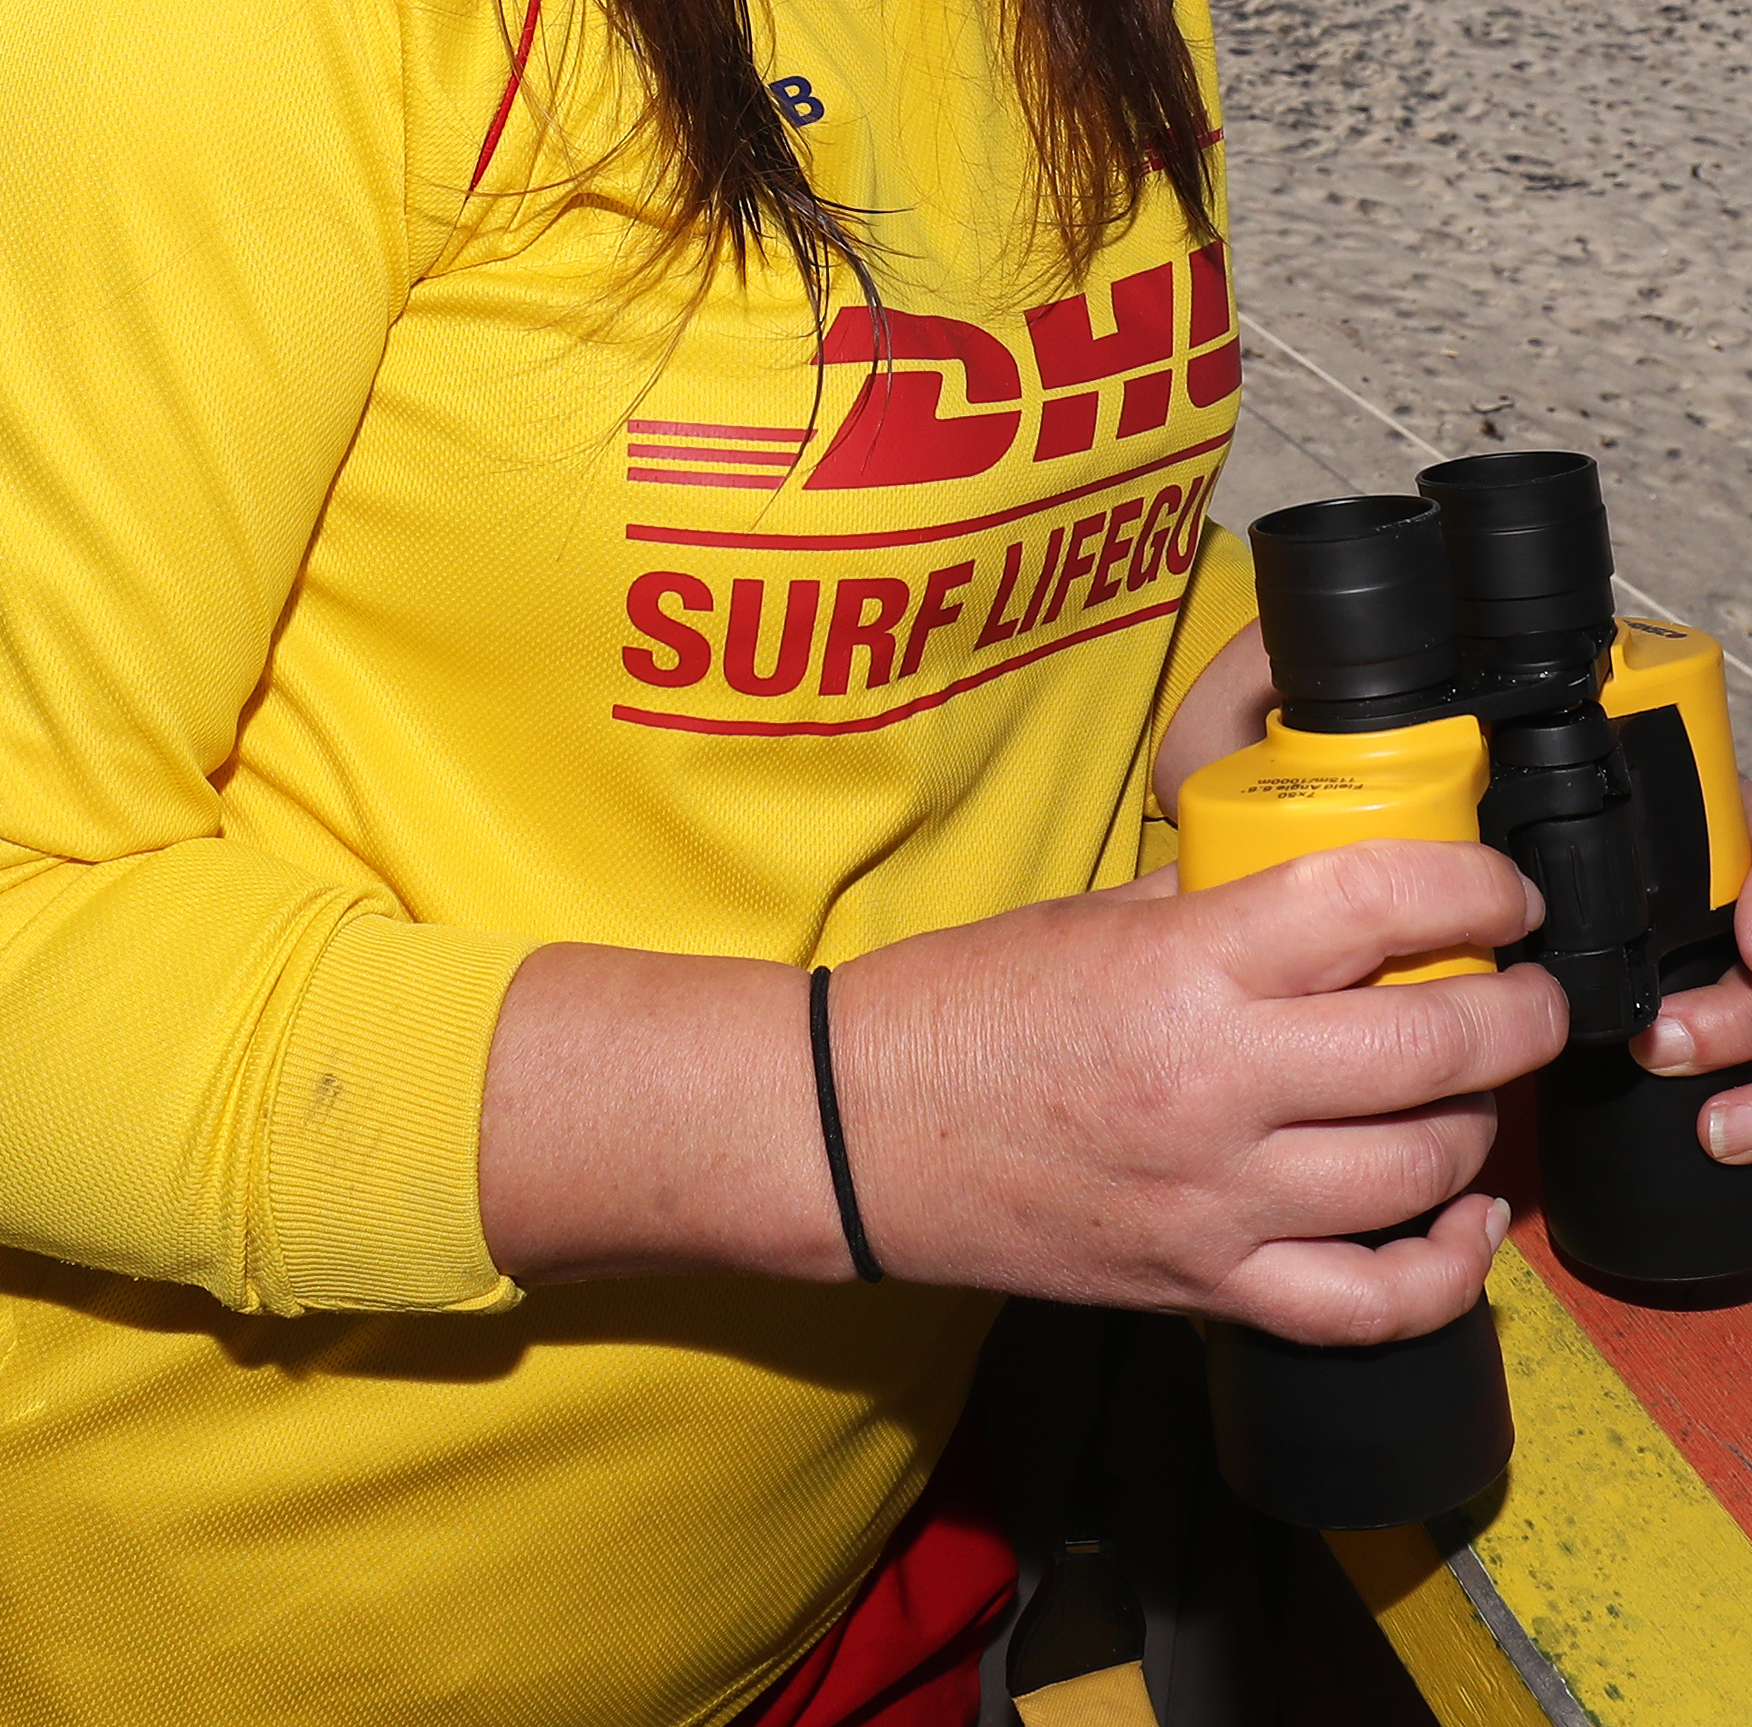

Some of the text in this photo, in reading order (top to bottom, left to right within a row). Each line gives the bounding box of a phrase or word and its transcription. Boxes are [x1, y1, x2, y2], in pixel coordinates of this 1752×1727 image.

[622, 559, 976, 697] SURF
[1275, 783, 1323, 791] Angle
[1277, 791, 1315, 799] 7x50
